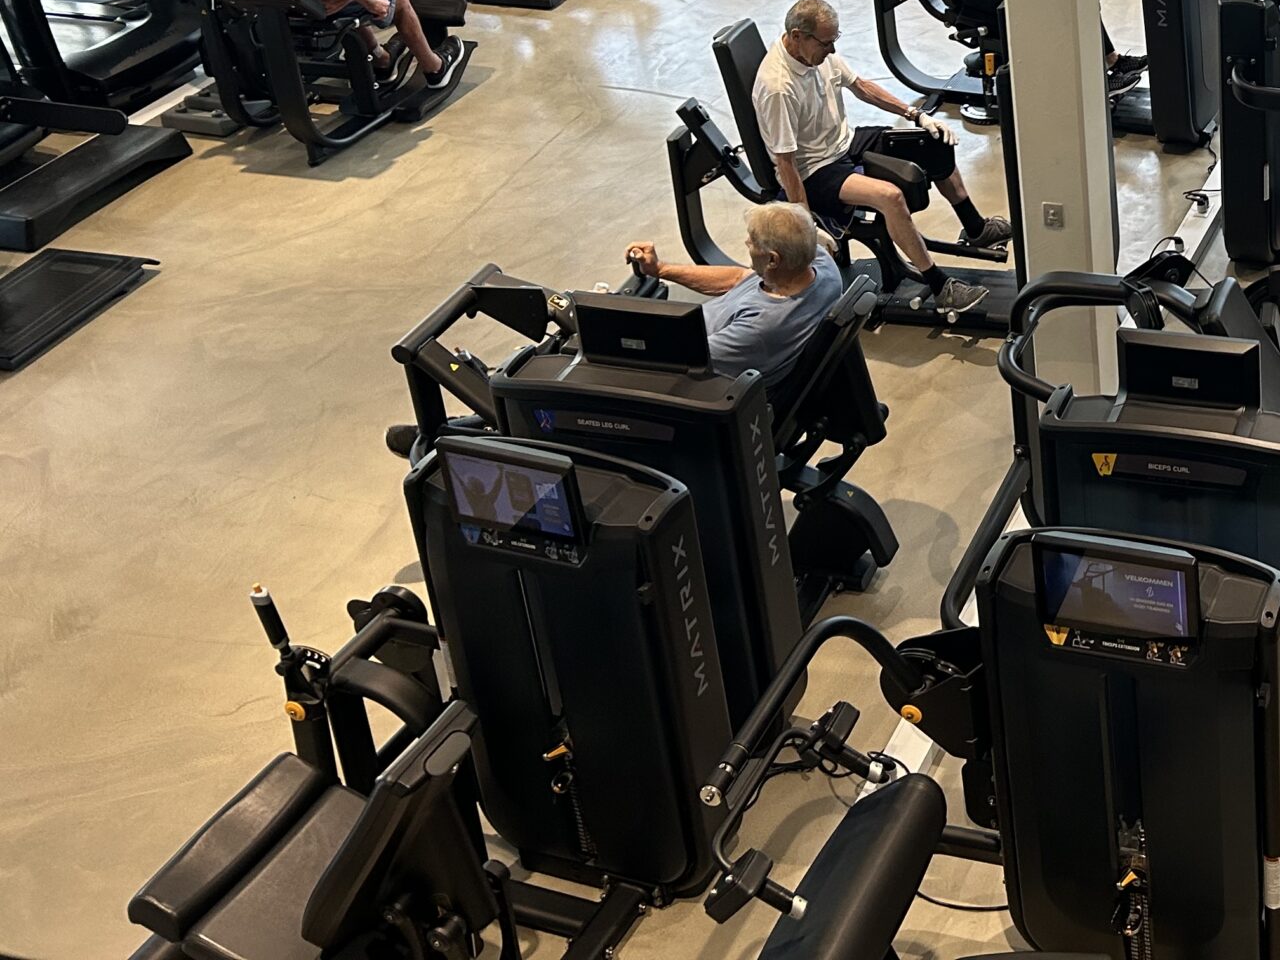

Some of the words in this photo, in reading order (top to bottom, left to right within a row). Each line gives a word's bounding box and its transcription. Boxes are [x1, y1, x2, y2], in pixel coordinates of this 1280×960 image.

[577, 418, 600, 427] SEATED
[601, 421, 613, 429] LEG
[614, 422, 631, 431] CURL
[1147, 463, 1172, 472] BICEPS
[1172, 466, 1190, 474] CURL
[750, 413, 780, 567] MATRIX
[1124, 574, 1174, 588] VELKOMMEN
[672, 534, 709, 696] MATRIX
